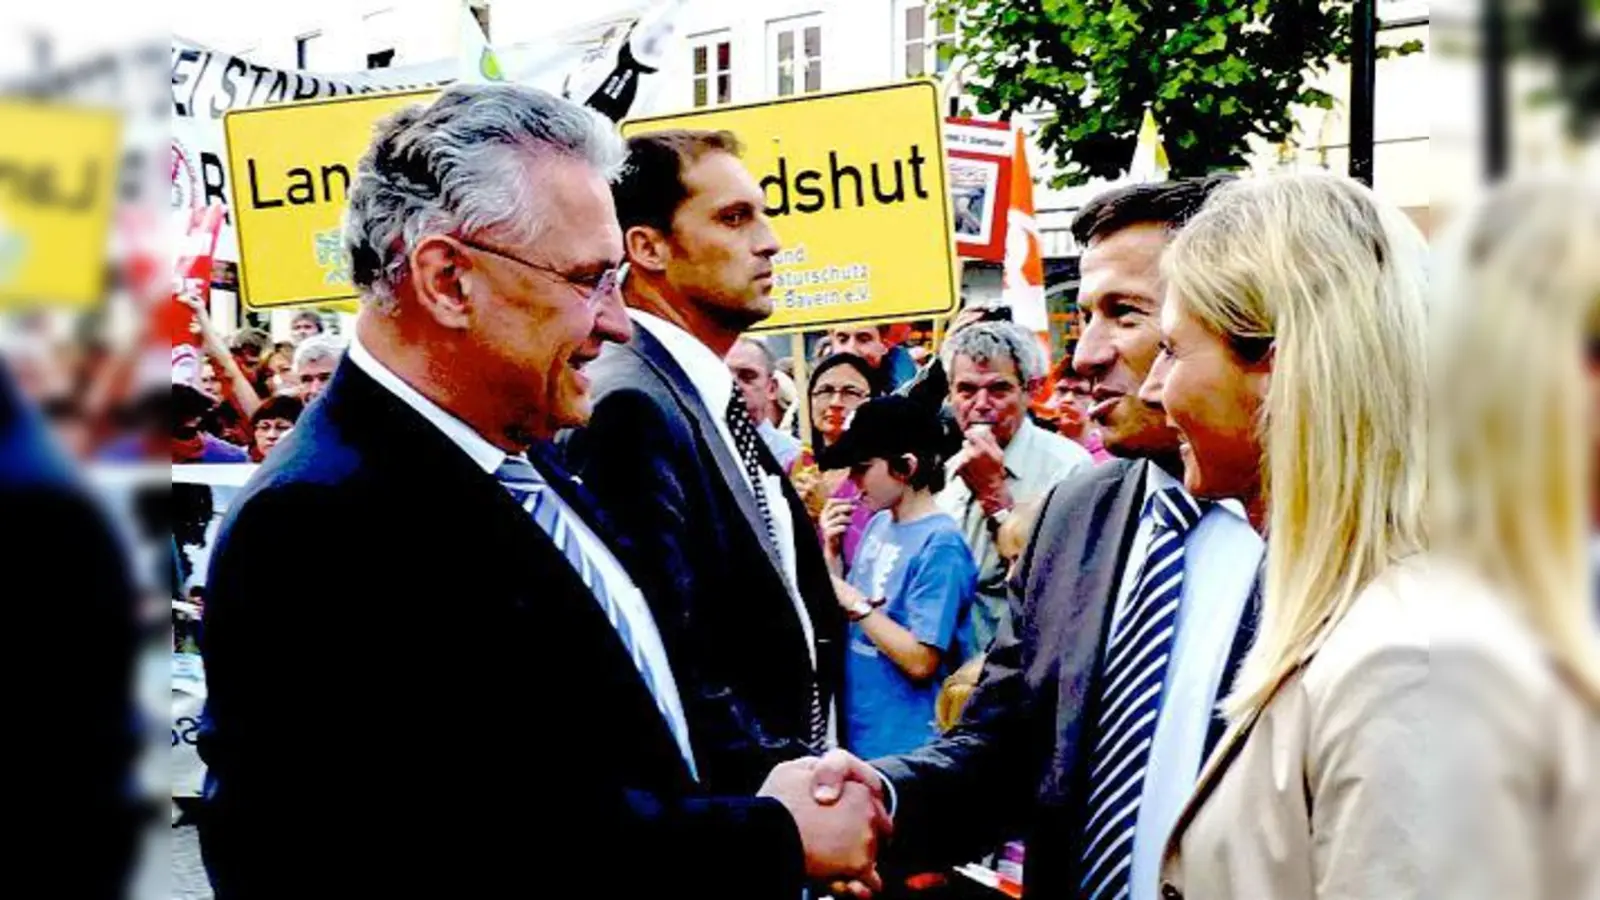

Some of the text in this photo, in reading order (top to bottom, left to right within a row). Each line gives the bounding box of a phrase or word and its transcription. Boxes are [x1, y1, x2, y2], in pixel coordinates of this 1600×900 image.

[200, 151, 227, 207] R
[247, 157, 350, 209] Lan
[759, 144, 928, 217] dshut
[772, 244, 805, 265] und
[774, 264, 868, 288] aturschutz
